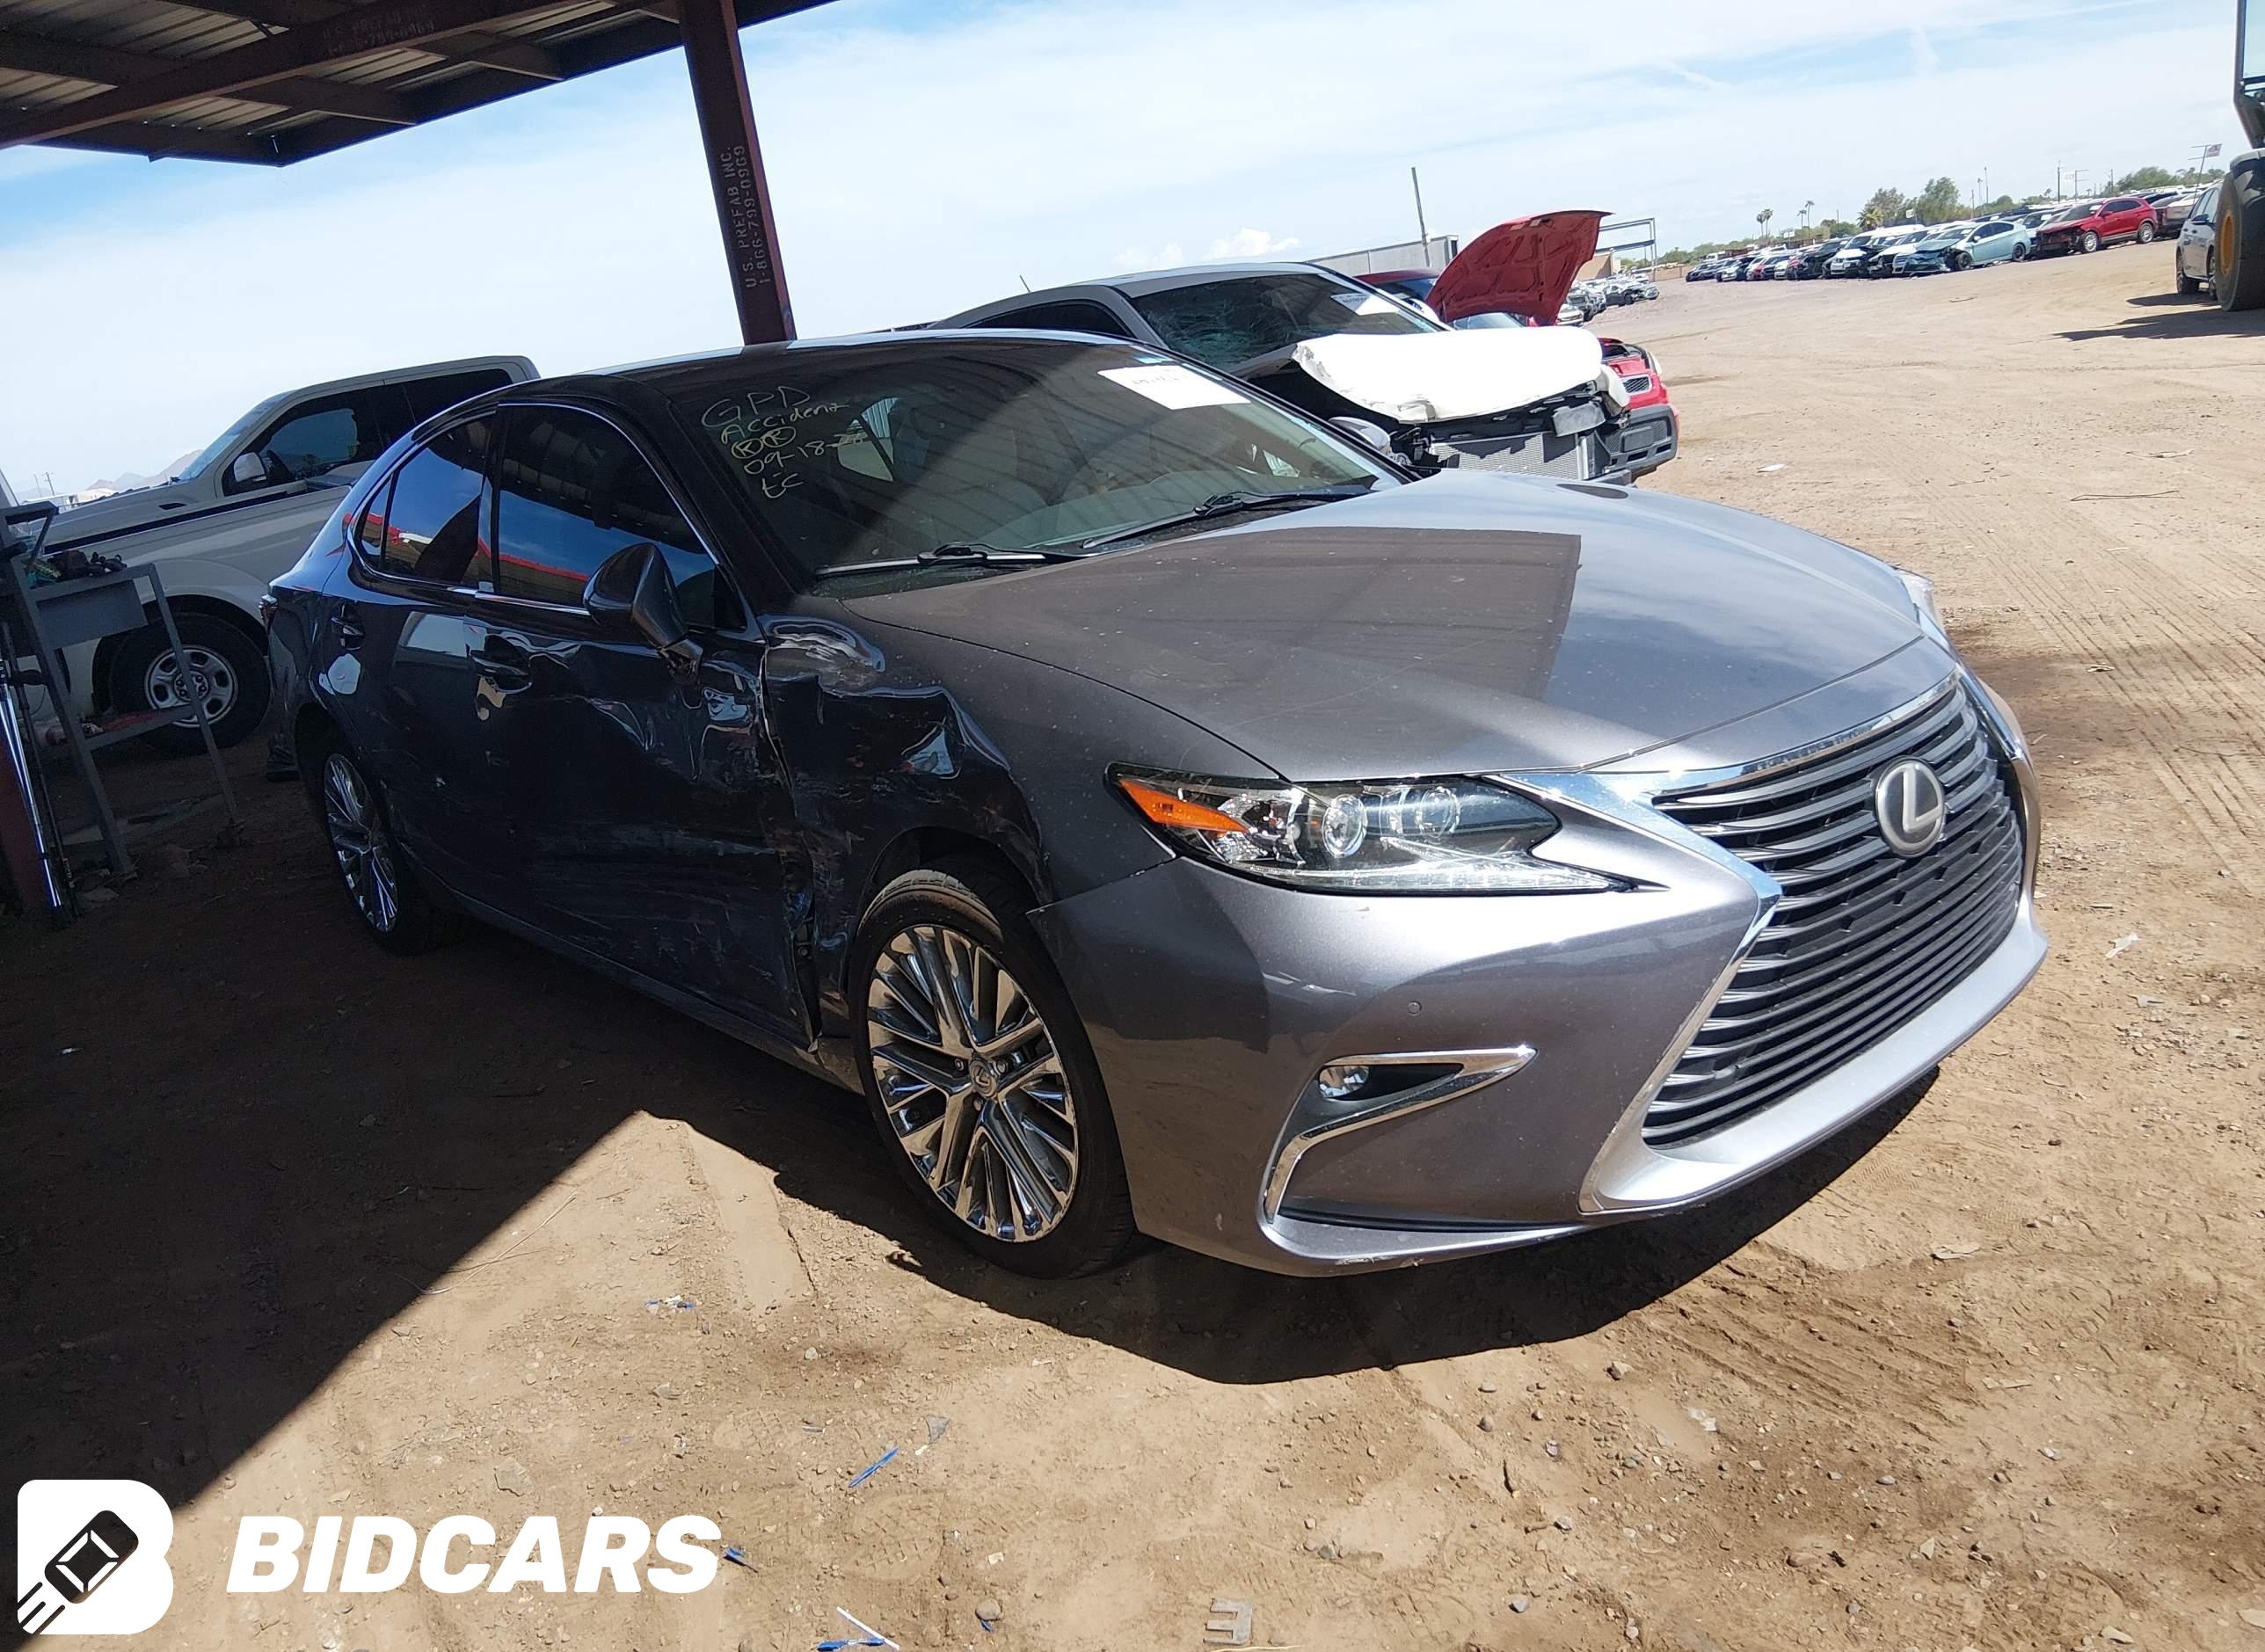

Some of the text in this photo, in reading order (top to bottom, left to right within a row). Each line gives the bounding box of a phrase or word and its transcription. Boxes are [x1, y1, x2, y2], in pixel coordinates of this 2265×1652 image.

[720, 147, 757, 287] U.S. PREFAB INC.
[732, 145, 771, 284] 1-866-799-0969
[701, 385, 811, 428] GPD
